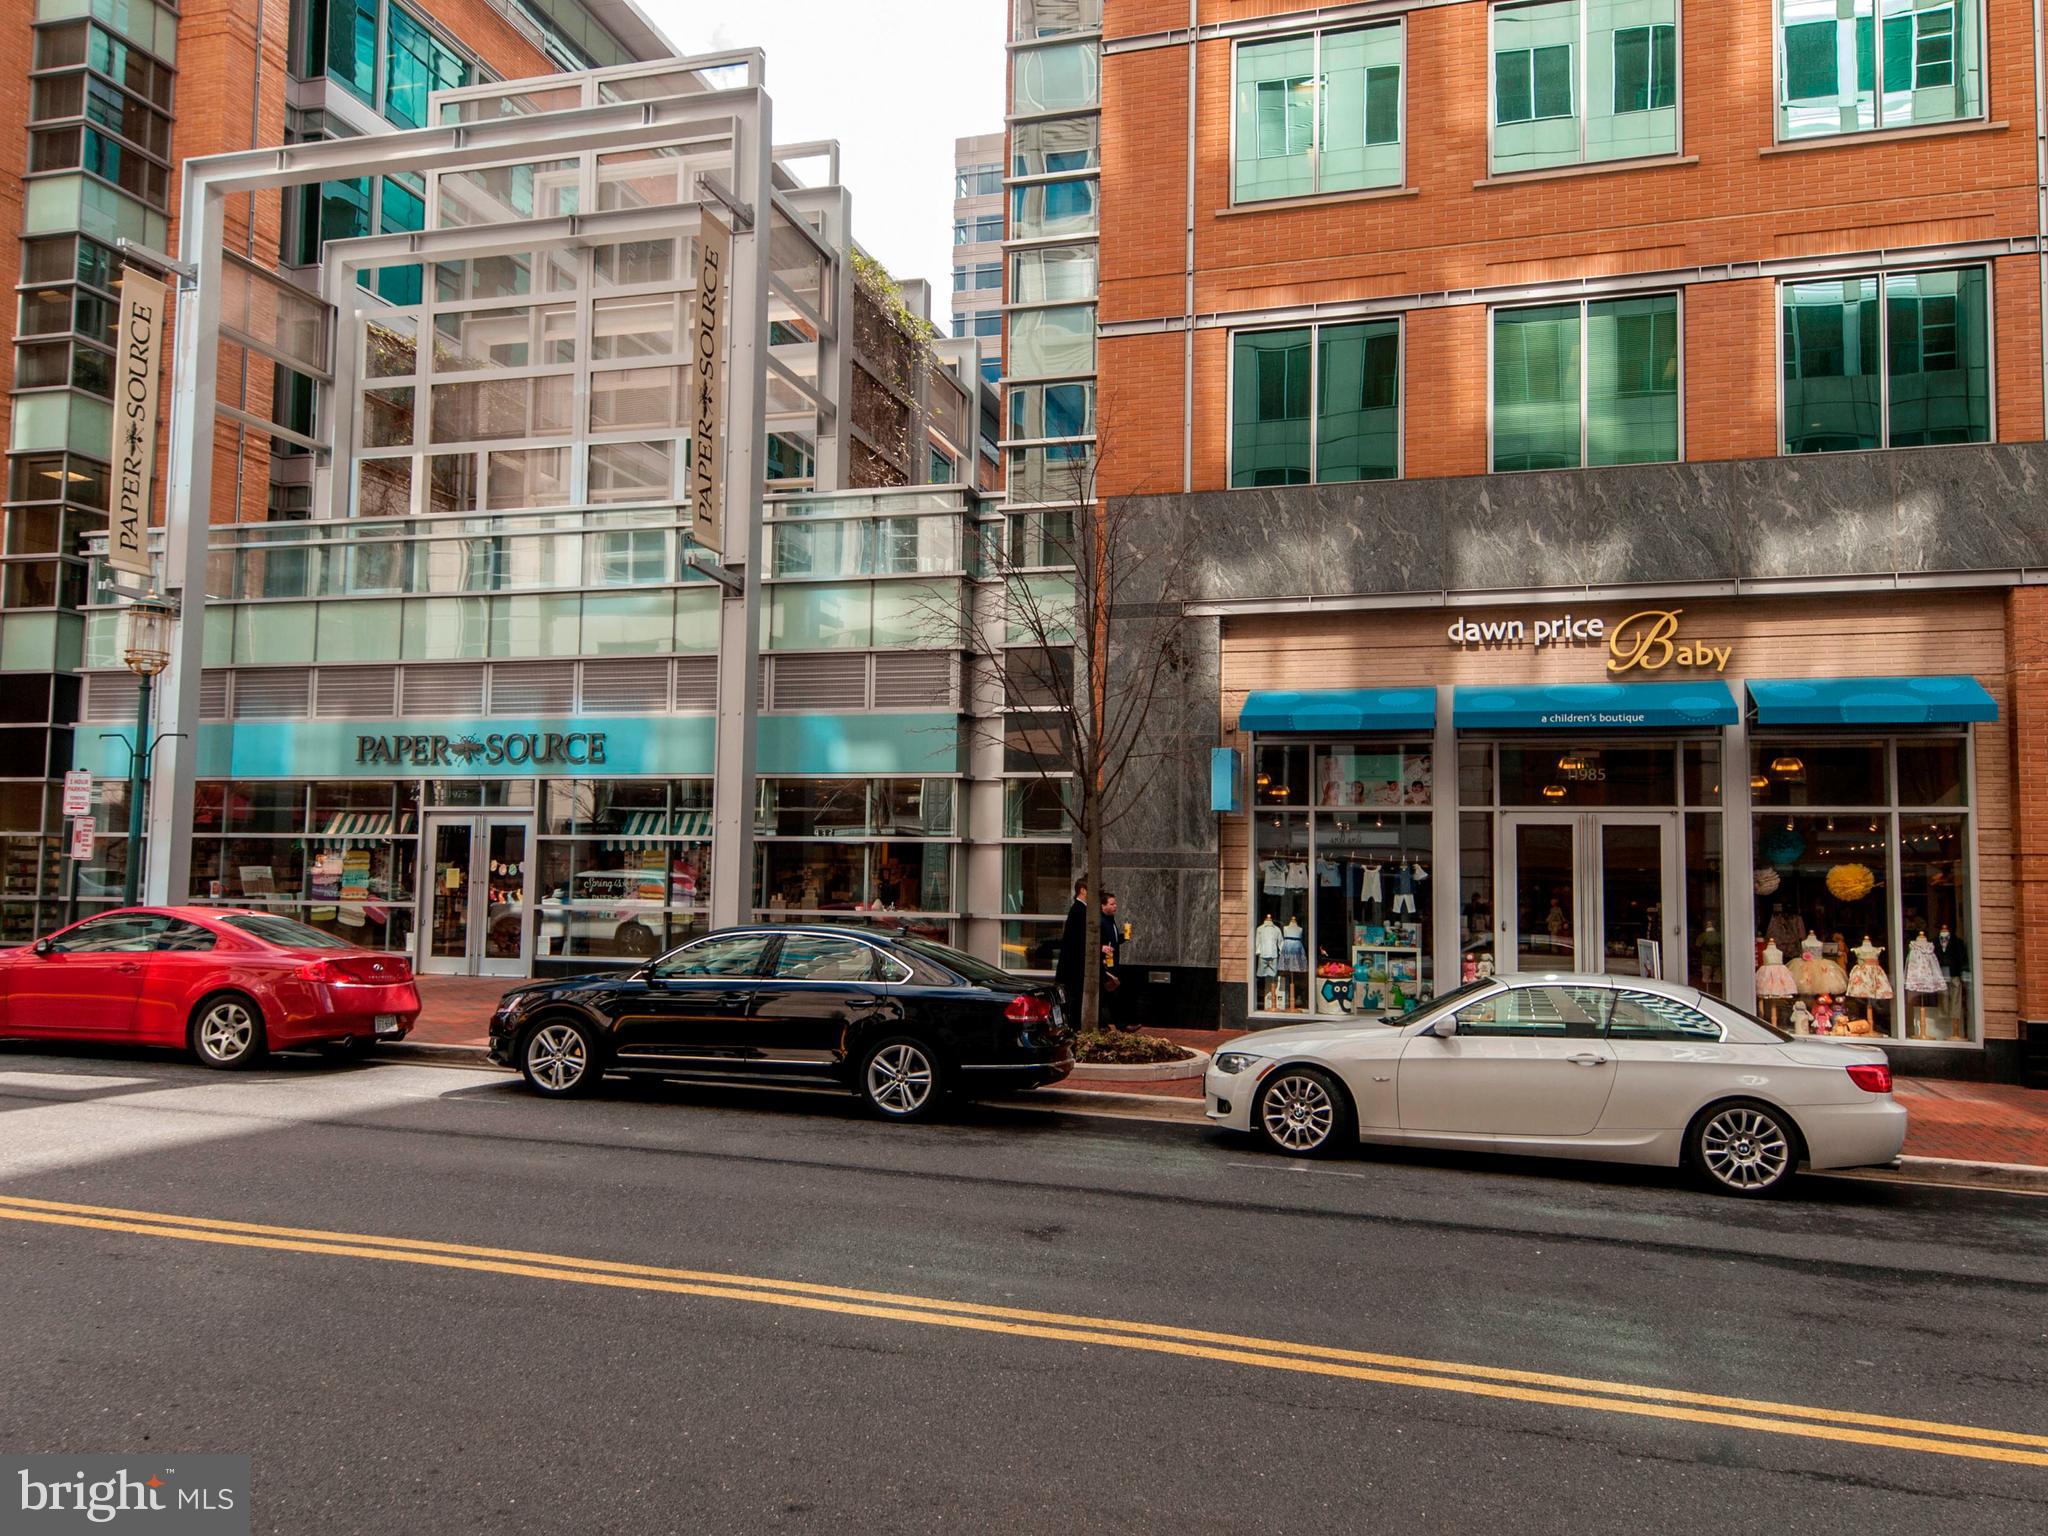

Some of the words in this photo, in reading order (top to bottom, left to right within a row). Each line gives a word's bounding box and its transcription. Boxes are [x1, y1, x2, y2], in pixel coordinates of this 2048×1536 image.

[700, 245, 718, 381] SOURCE
[126, 301, 152, 422] SOURCE
[698, 418, 713, 525] PAPER
[120, 456, 142, 553] PAPER
[1447, 616, 1524, 642] dawn
[1534, 614, 1604, 646] price
[1606, 608, 1732, 672] Baby
[356, 734, 451, 765] PAPER
[485, 732, 607, 765] SOURCE
[1541, 715, 1547, 723] a
[1549, 713, 1597, 723] children's
[1599, 712, 1645, 724] boutique
[583, 877, 613, 892] Spring
